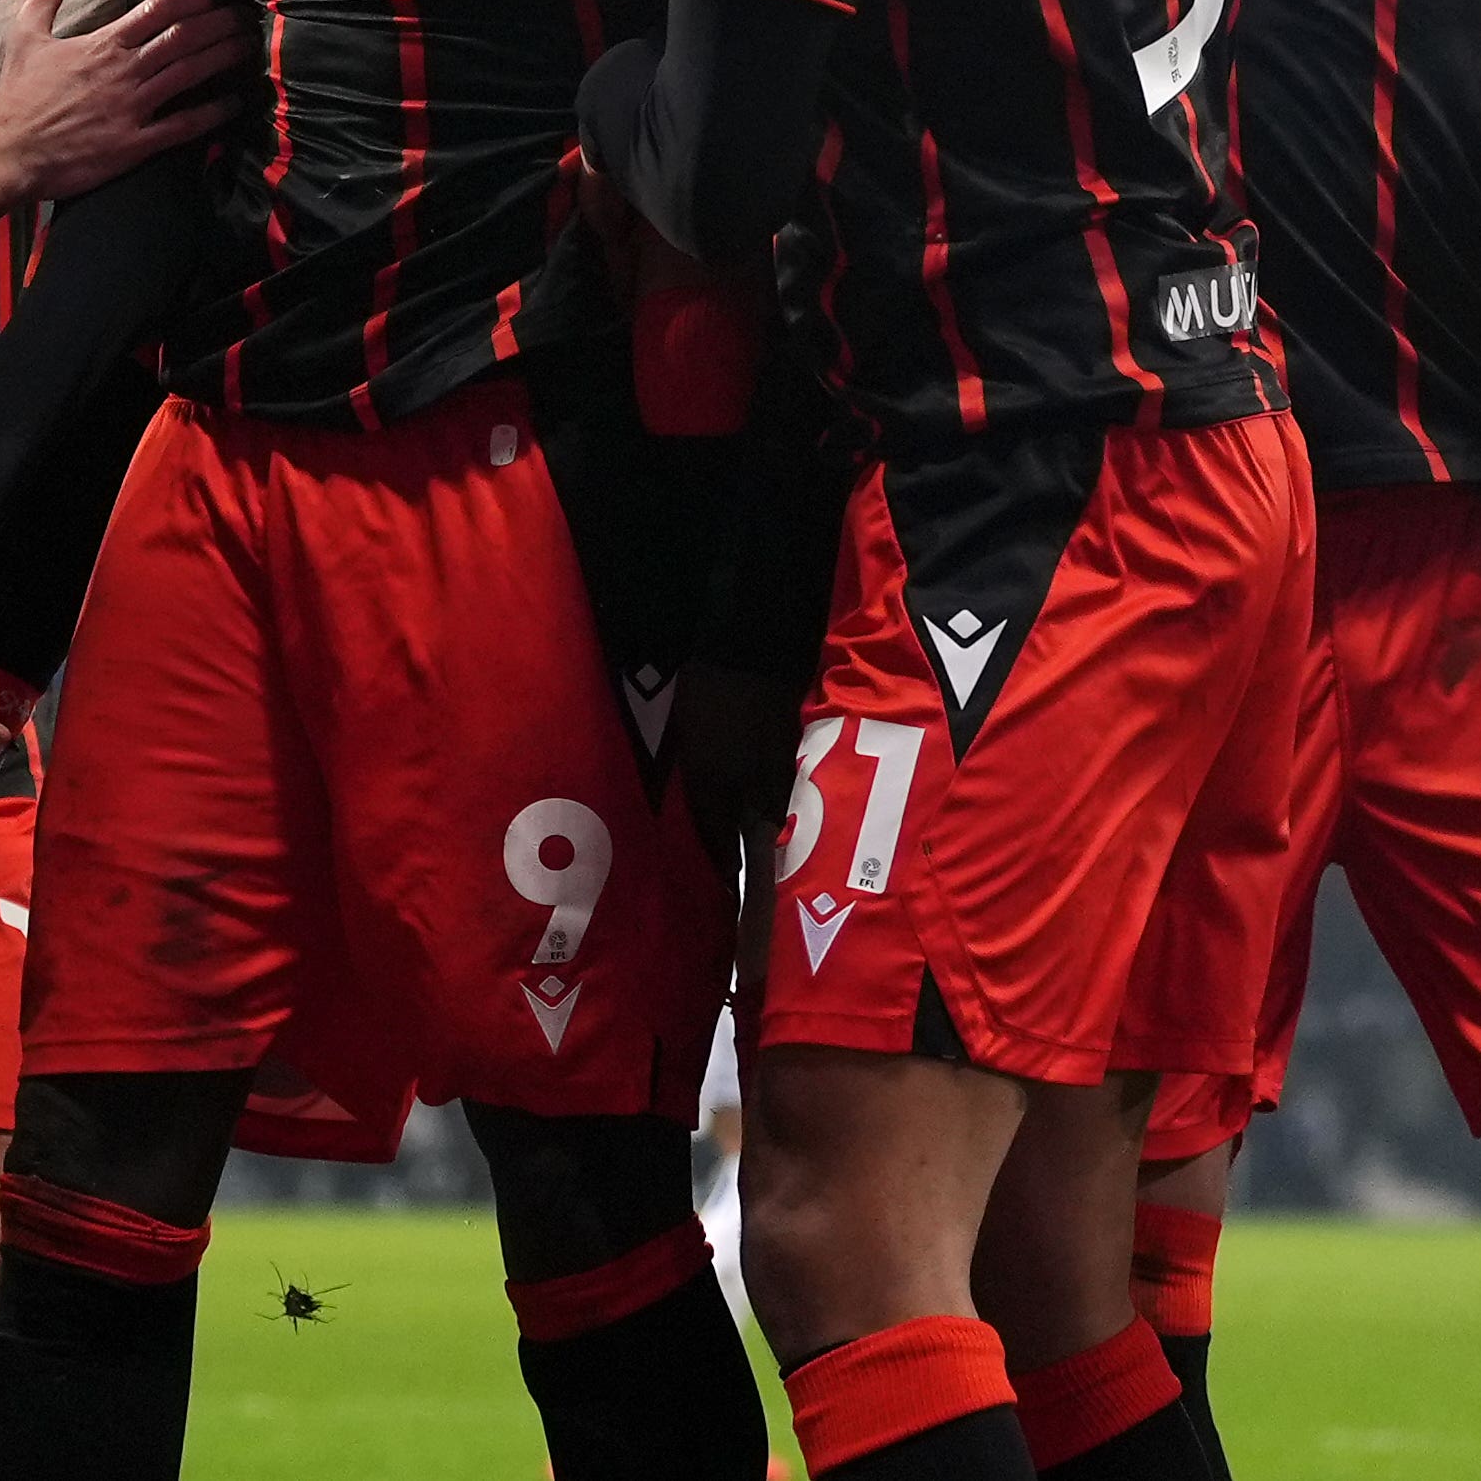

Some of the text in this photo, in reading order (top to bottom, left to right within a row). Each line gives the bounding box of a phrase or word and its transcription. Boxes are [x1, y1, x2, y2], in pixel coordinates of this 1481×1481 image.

[775, 716, 926, 895] 31
[503, 797, 613, 965] 9
[858, 878, 875, 889] EFL
[550, 951, 566, 960] EFL
